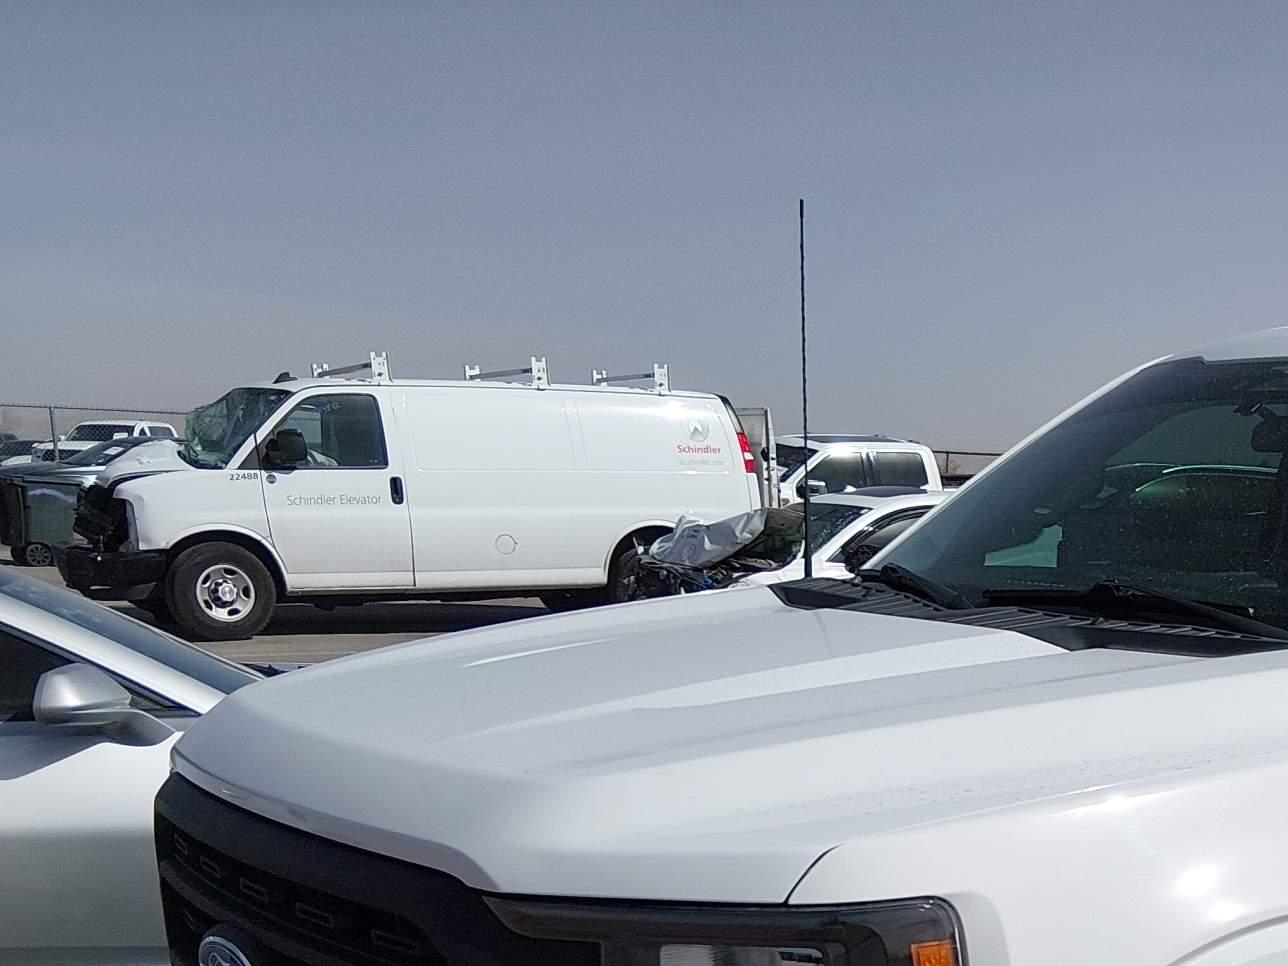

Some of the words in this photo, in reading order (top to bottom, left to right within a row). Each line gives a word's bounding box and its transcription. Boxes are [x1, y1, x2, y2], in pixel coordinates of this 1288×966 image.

[676, 444, 721, 455] Schindler
[229, 472, 259, 481] 22488
[287, 494, 337, 506] Schindler
[340, 493, 382, 505] Elevator
